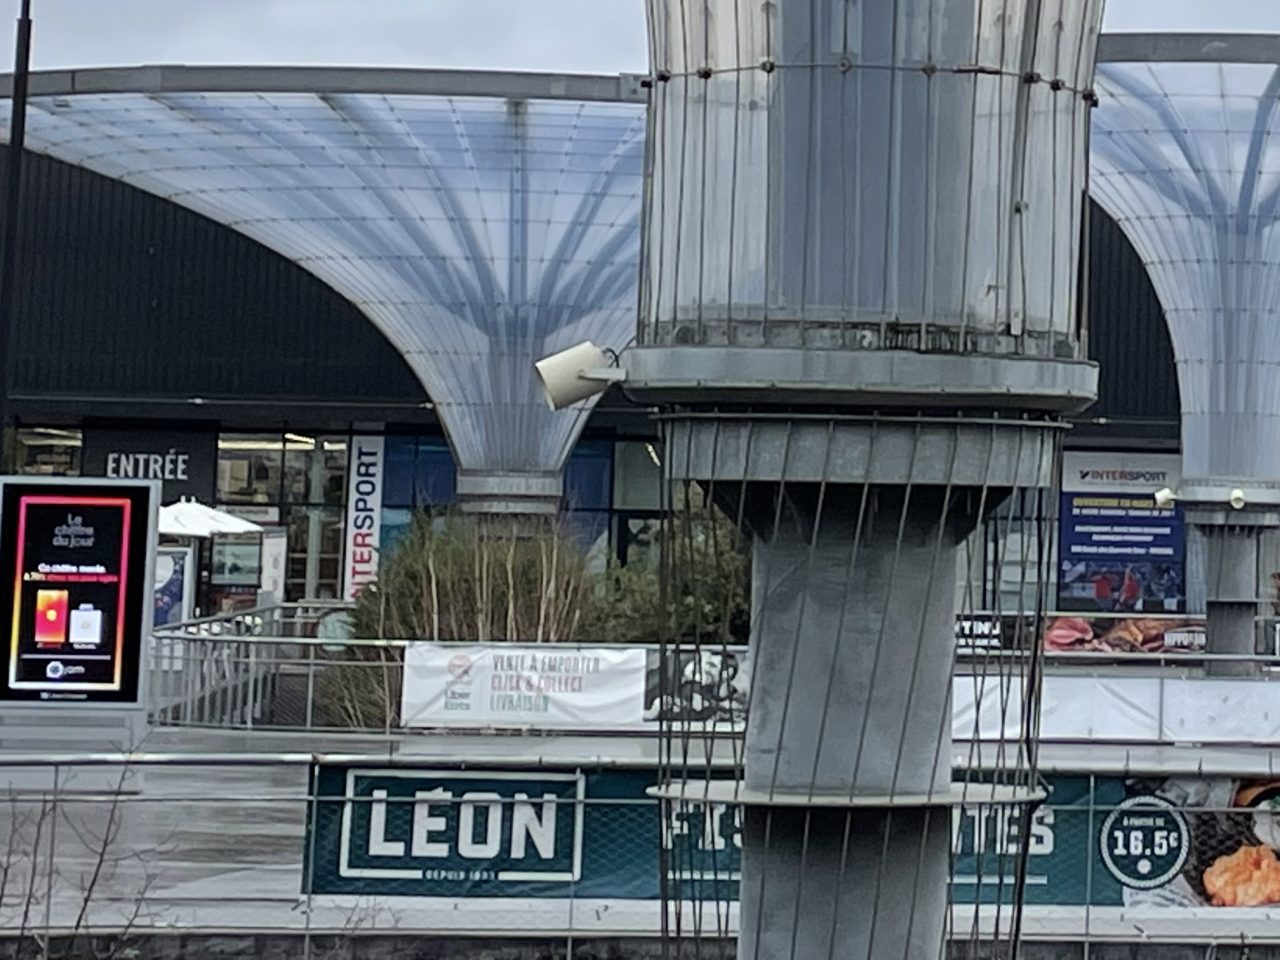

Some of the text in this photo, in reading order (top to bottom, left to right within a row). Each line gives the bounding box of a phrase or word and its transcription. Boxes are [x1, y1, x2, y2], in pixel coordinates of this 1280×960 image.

[106, 448, 189, 480] ENTRÉE
[1091, 470, 1168, 482] INTERSPORT
[351, 446, 378, 598] NTERSPORT
